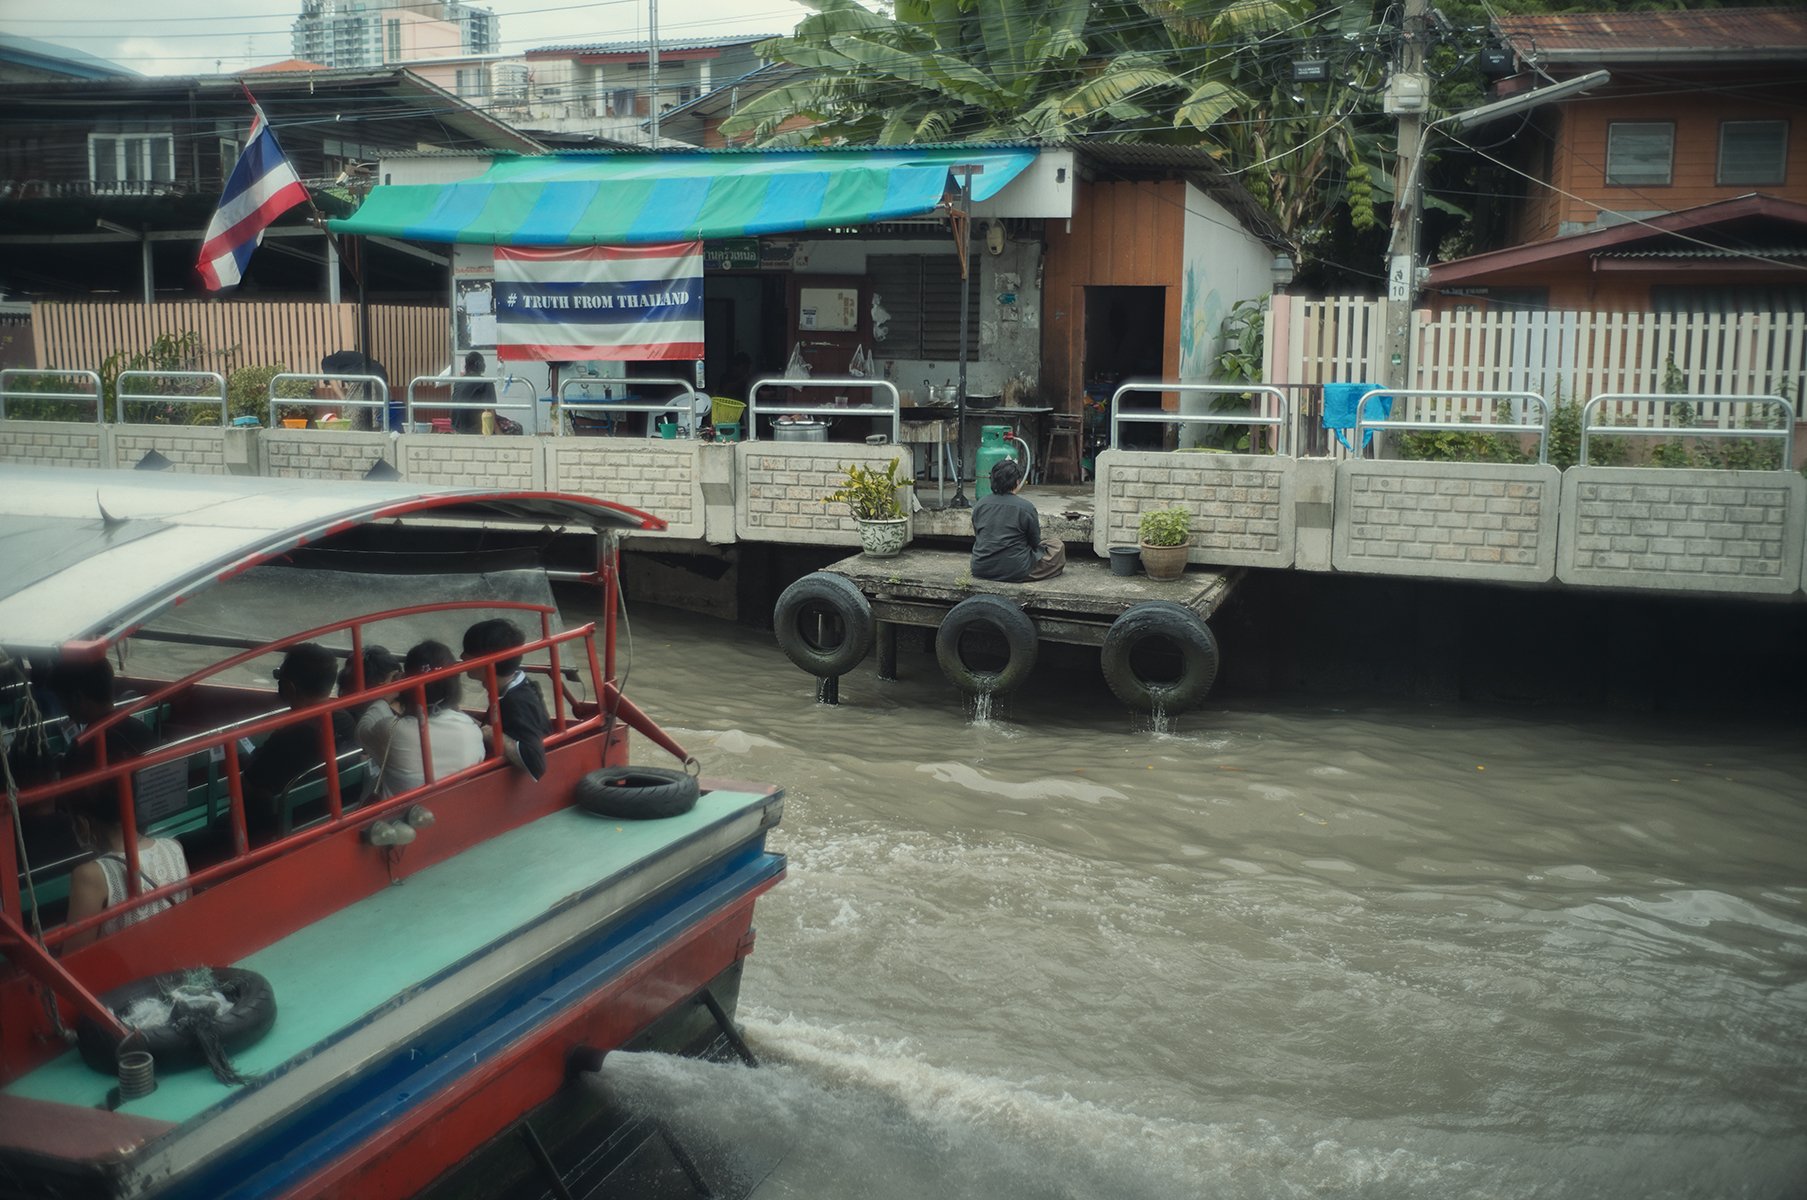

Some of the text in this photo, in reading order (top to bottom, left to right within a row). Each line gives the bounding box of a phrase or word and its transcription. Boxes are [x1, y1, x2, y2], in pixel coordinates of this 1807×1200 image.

[704, 246, 757, 261] านครัวเหนือ
[1393, 286, 1404, 296] 10
[507, 291, 690, 309] # TRUTH FROM THAILAND
